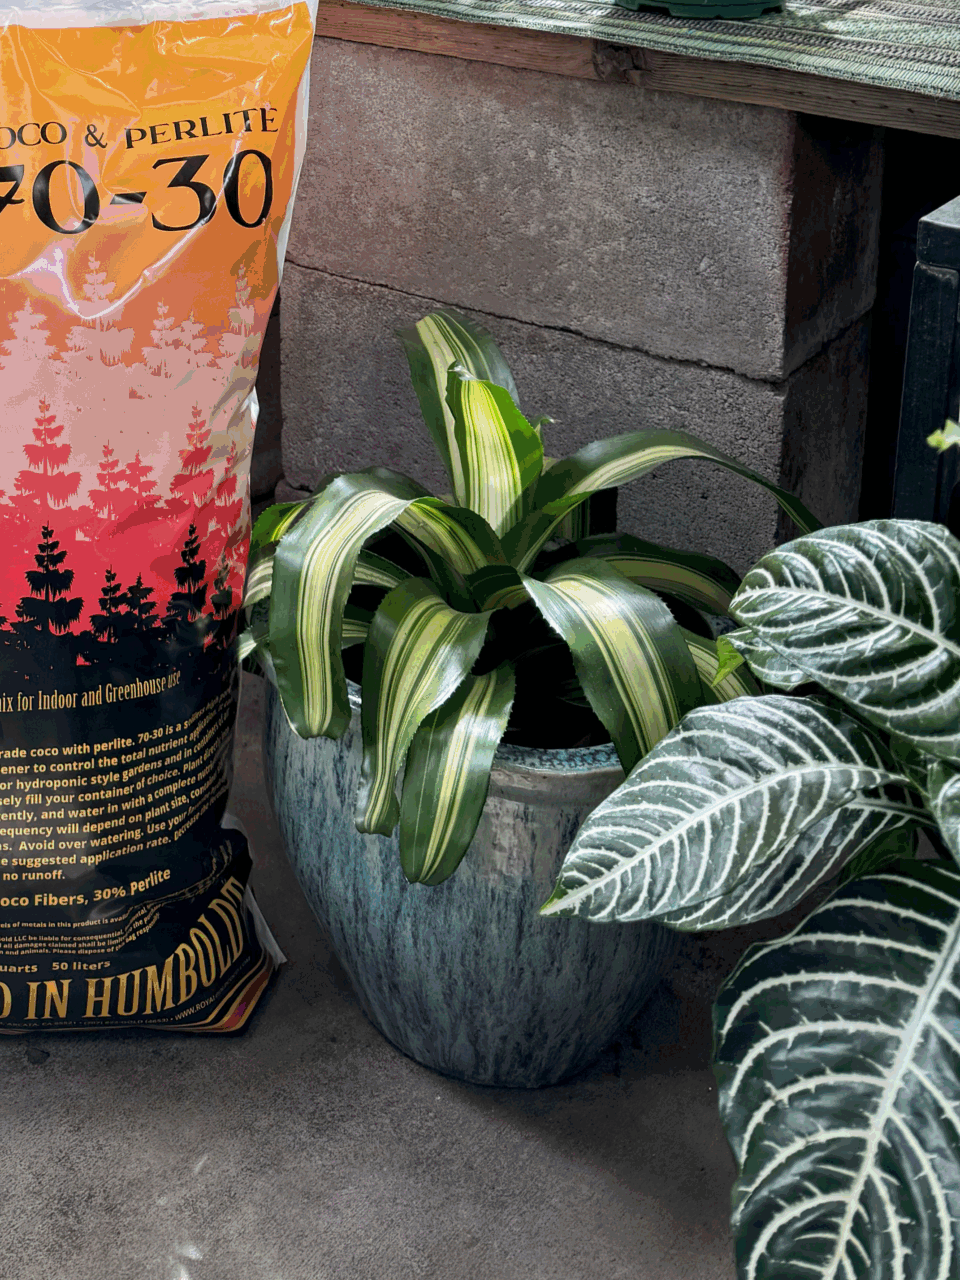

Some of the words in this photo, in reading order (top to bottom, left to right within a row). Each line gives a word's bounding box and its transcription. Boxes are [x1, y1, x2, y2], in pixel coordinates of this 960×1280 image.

[84, 123, 108, 149] &
[125, 107, 279, 149] PERLITE
[17, 692, 34, 711] for
[38, 689, 78, 710] Indoor
[81, 685, 102, 707] and
[106, 677, 166, 703] Greenhouse
[167, 670, 181, 689] use
[30, 748, 59, 757] coco
[62, 743, 90, 755] with
[94, 738, 135, 755] perlite.
[138, 728, 163, 743] 70-30
[165, 725, 173, 735] is
[176, 723, 181, 732] a
[33, 764, 46, 773] to
[50, 758, 94, 772] control
[98, 756, 118, 768] the
[121, 747, 146, 764] total
[148, 735, 188, 756] nutrient
[0, 782, 13, 790] or
[16, 776, 87, 792] hydroponic
[91, 772, 120, 786] style
[122, 760, 162, 782] gardens
[164, 750, 182, 765] and
[184, 748, 192, 758] in
[25, 794, 42, 805] fill
[45, 794, 75, 807] your
[78, 784, 134, 802] container
[136, 777, 145, 790] of
[147, 769, 180, 785] choice.
[183, 755, 203, 773] Plant
[41, 808, 64, 819] and
[68, 807, 105, 818] water
[107, 803, 118, 813] in
[121, 795, 145, 810] with
[147, 793, 153, 802] a
[154, 776, 196, 799] complete
[56, 823, 79, 834] will
[82, 815, 125, 834] depend
[128, 814, 142, 823] on
[145, 802, 170, 822] plant
[171, 795, 189, 809] size,
[19, 840, 55, 851] Avoid
[58, 840, 87, 849] over
[90, 829, 144, 847] watering.
[147, 822, 166, 834] Use
[168, 812, 187, 830] your
[12, 854, 76, 868] suggested
[80, 843, 143, 866] application
[146, 836, 171, 849] rate.
[22, 869, 65, 880] runoff.
[35, 893, 88, 906] Fibers,
[93, 886, 126, 901] 30%
[130, 869, 170, 895] Perlite
[73, 919, 101, 928] product
[102, 917, 109, 925] is
[24, 979, 72, 1020] IN
[82, 876, 245, 1018] HUMBOLDT
[52, 962, 68, 970] 50
[73, 961, 110, 970] liters
